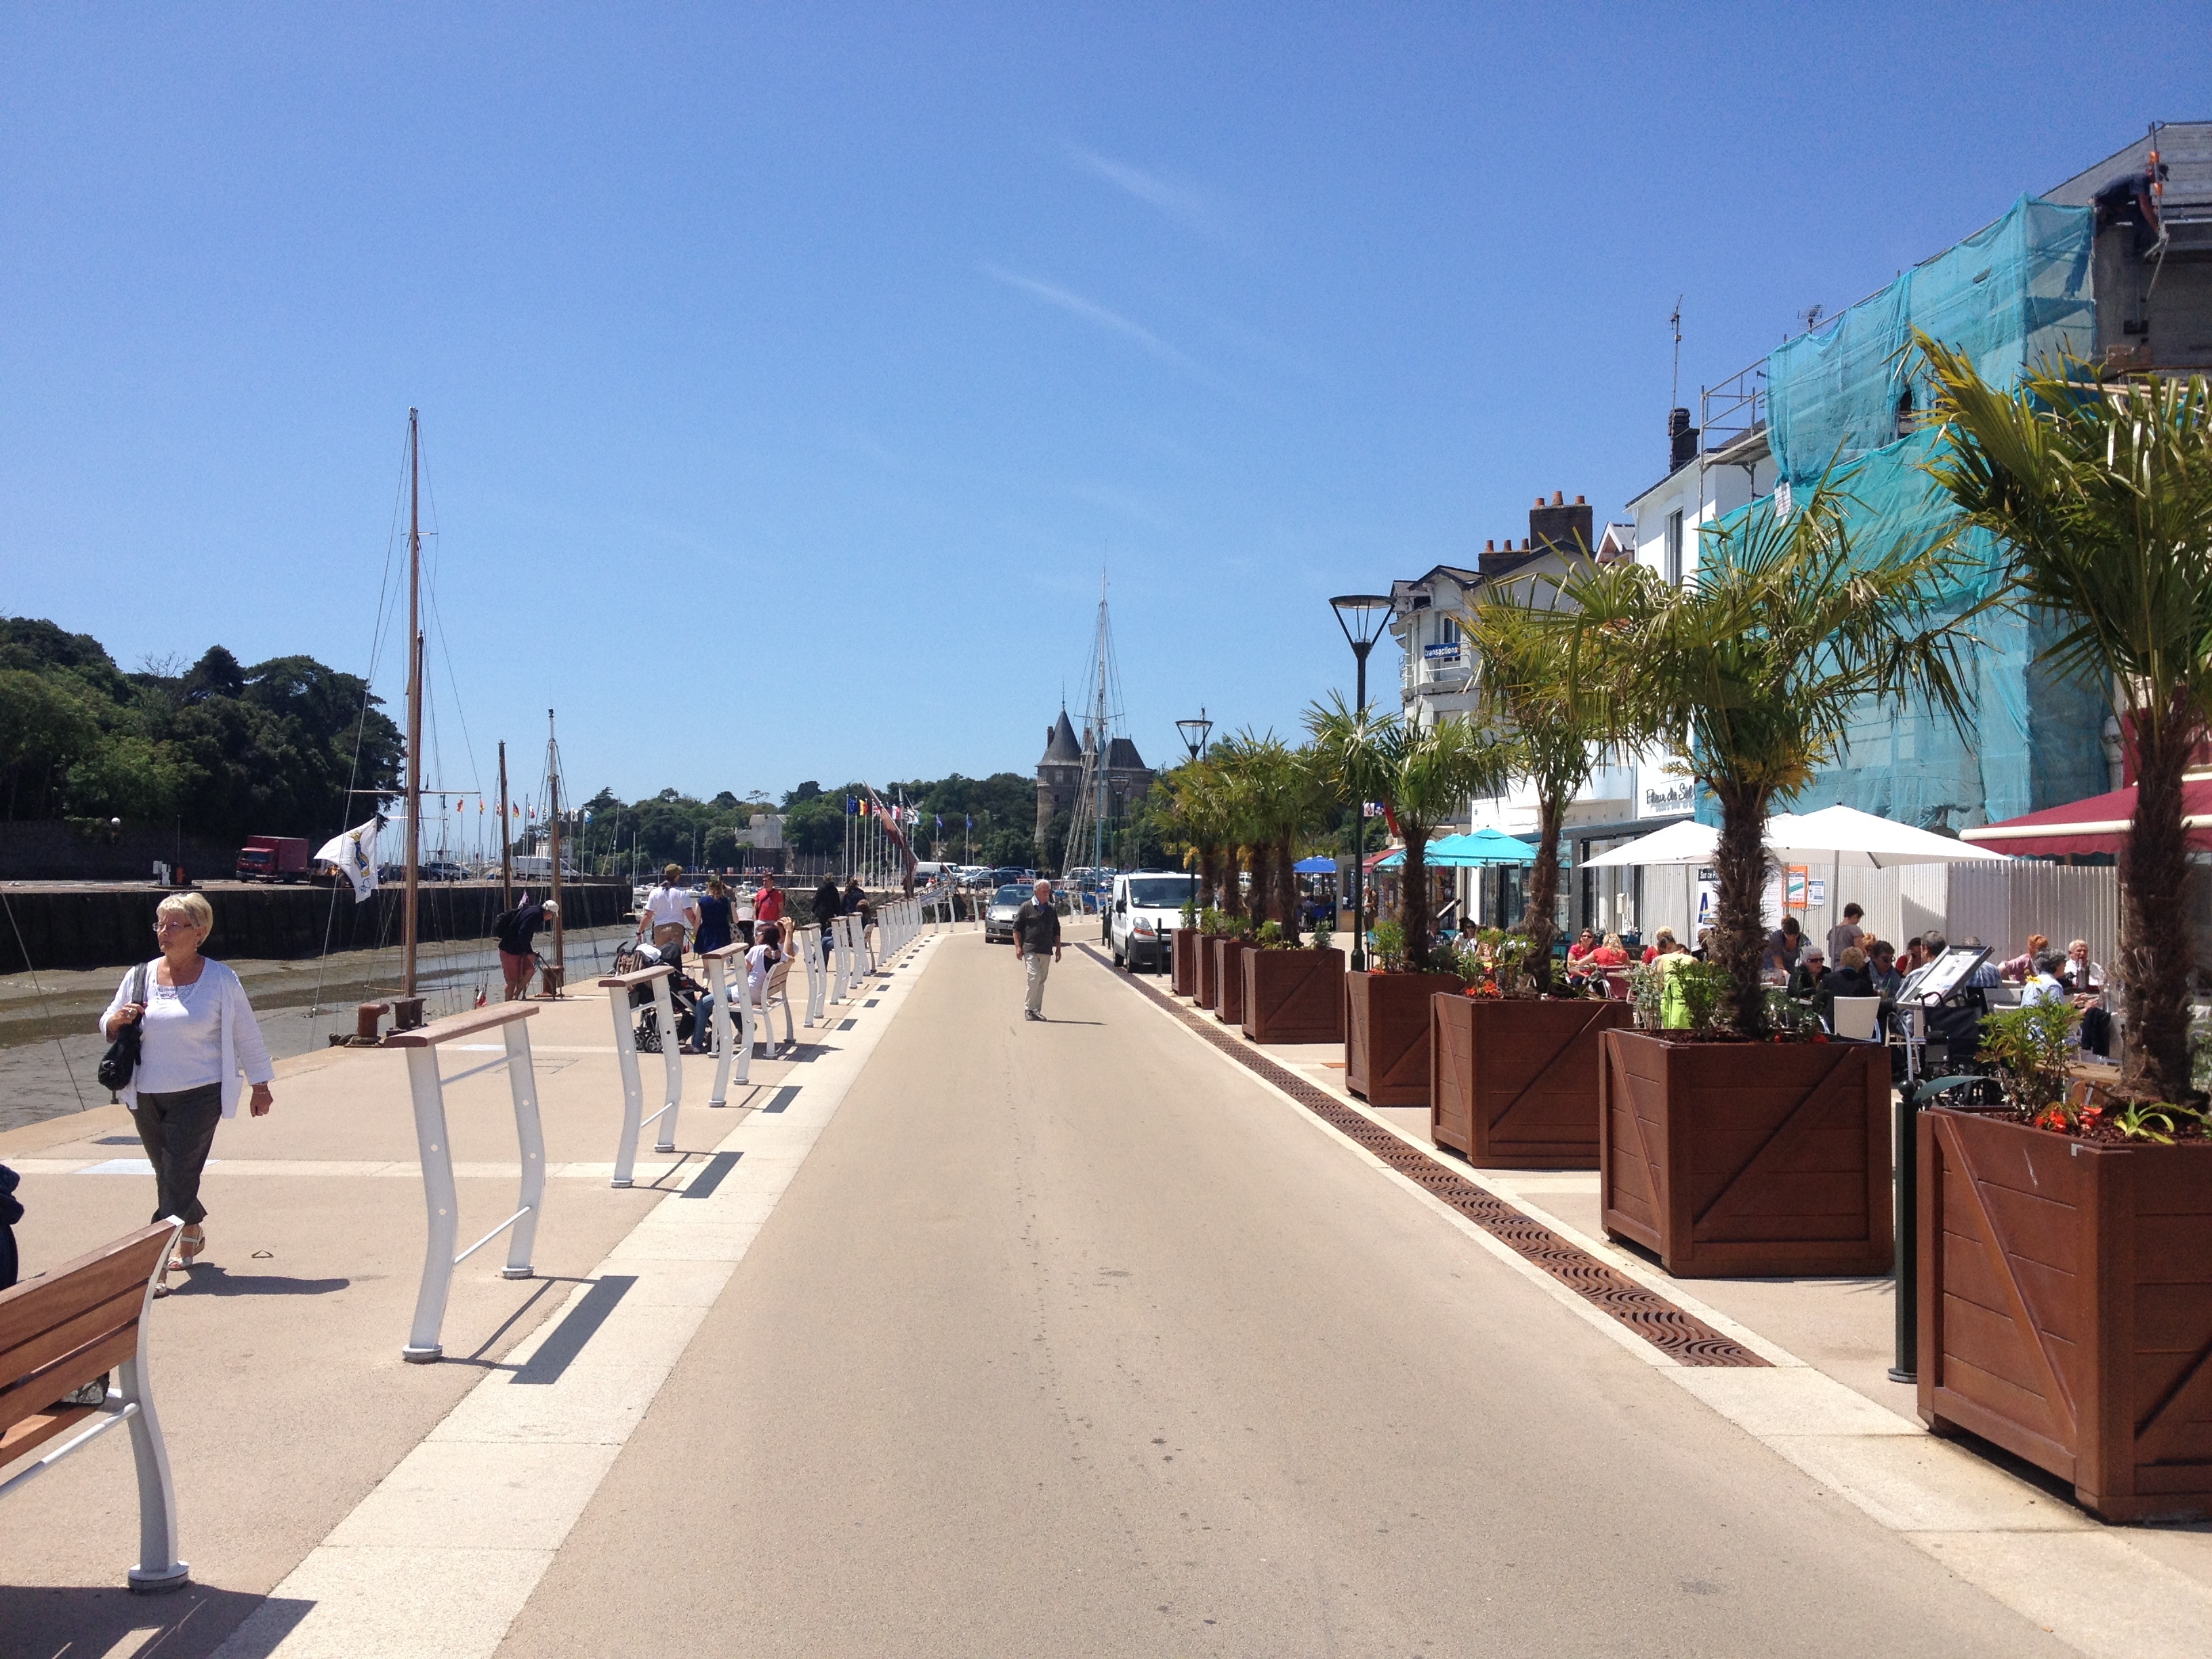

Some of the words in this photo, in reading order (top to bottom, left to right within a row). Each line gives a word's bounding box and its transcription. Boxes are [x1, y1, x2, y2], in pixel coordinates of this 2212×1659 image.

[1425, 647, 1458, 657] transactions
[1646, 788, 1667, 804] Fleur
[1666, 787, 1677, 802] de
[1678, 782, 1694, 800] Sel
